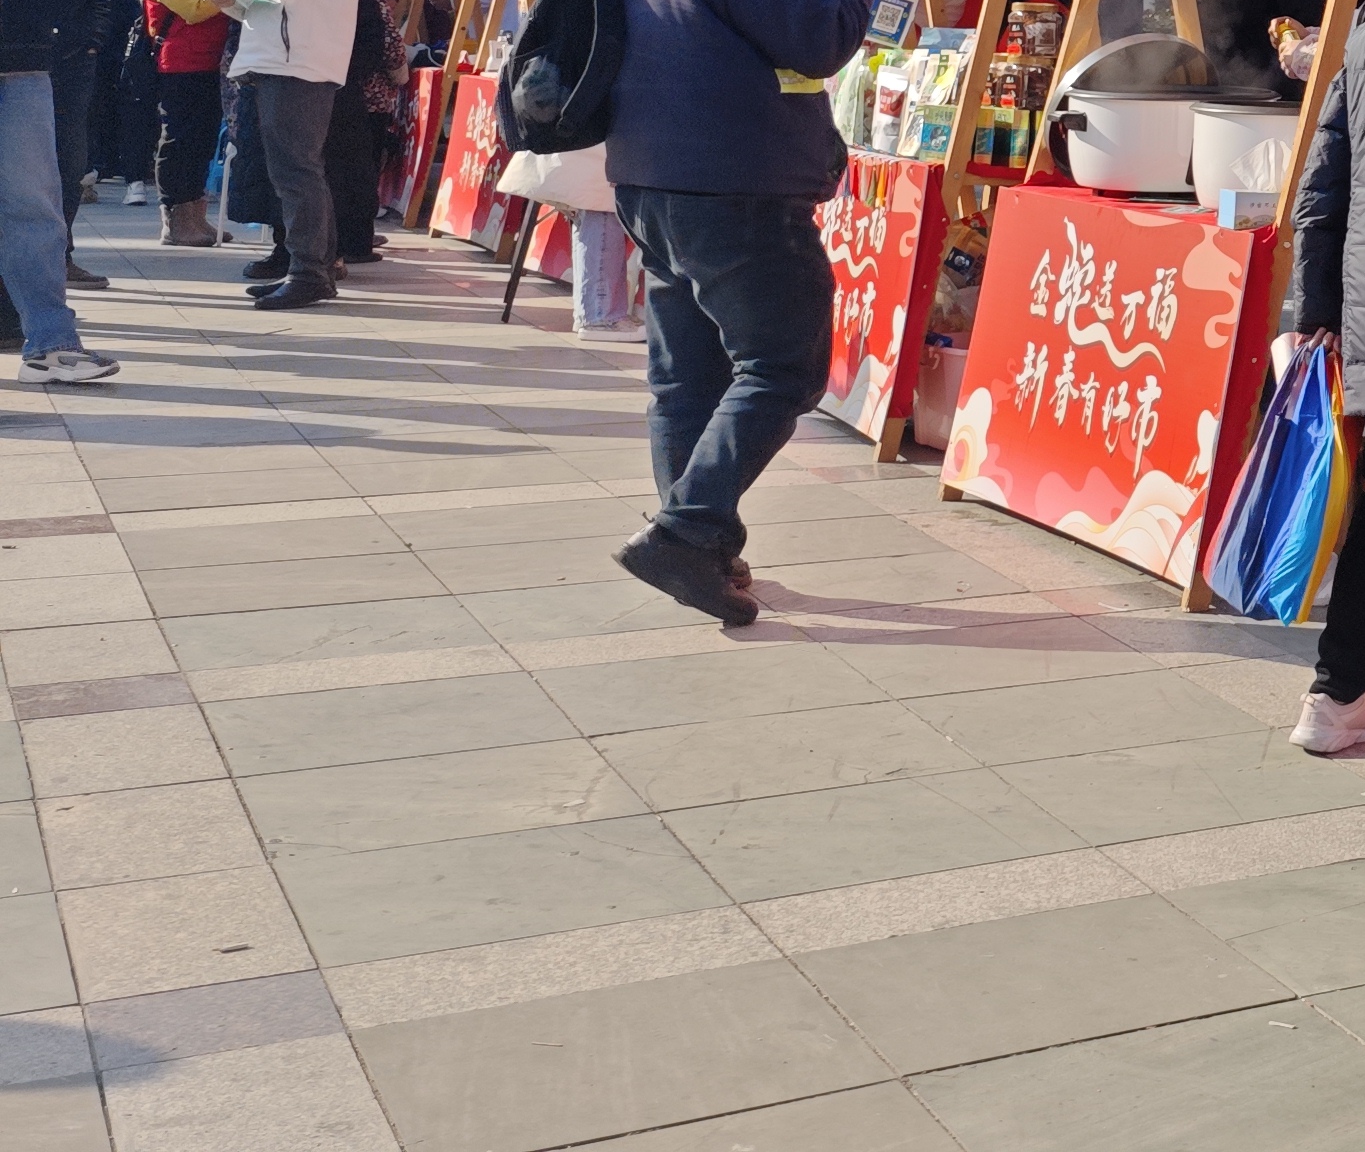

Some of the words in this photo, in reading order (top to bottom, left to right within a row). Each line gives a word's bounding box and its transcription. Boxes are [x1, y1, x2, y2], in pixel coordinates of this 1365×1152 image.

[1030, 216, 1178, 372] 金蛇送万福
[1015, 341, 1163, 479] 新春有好市
